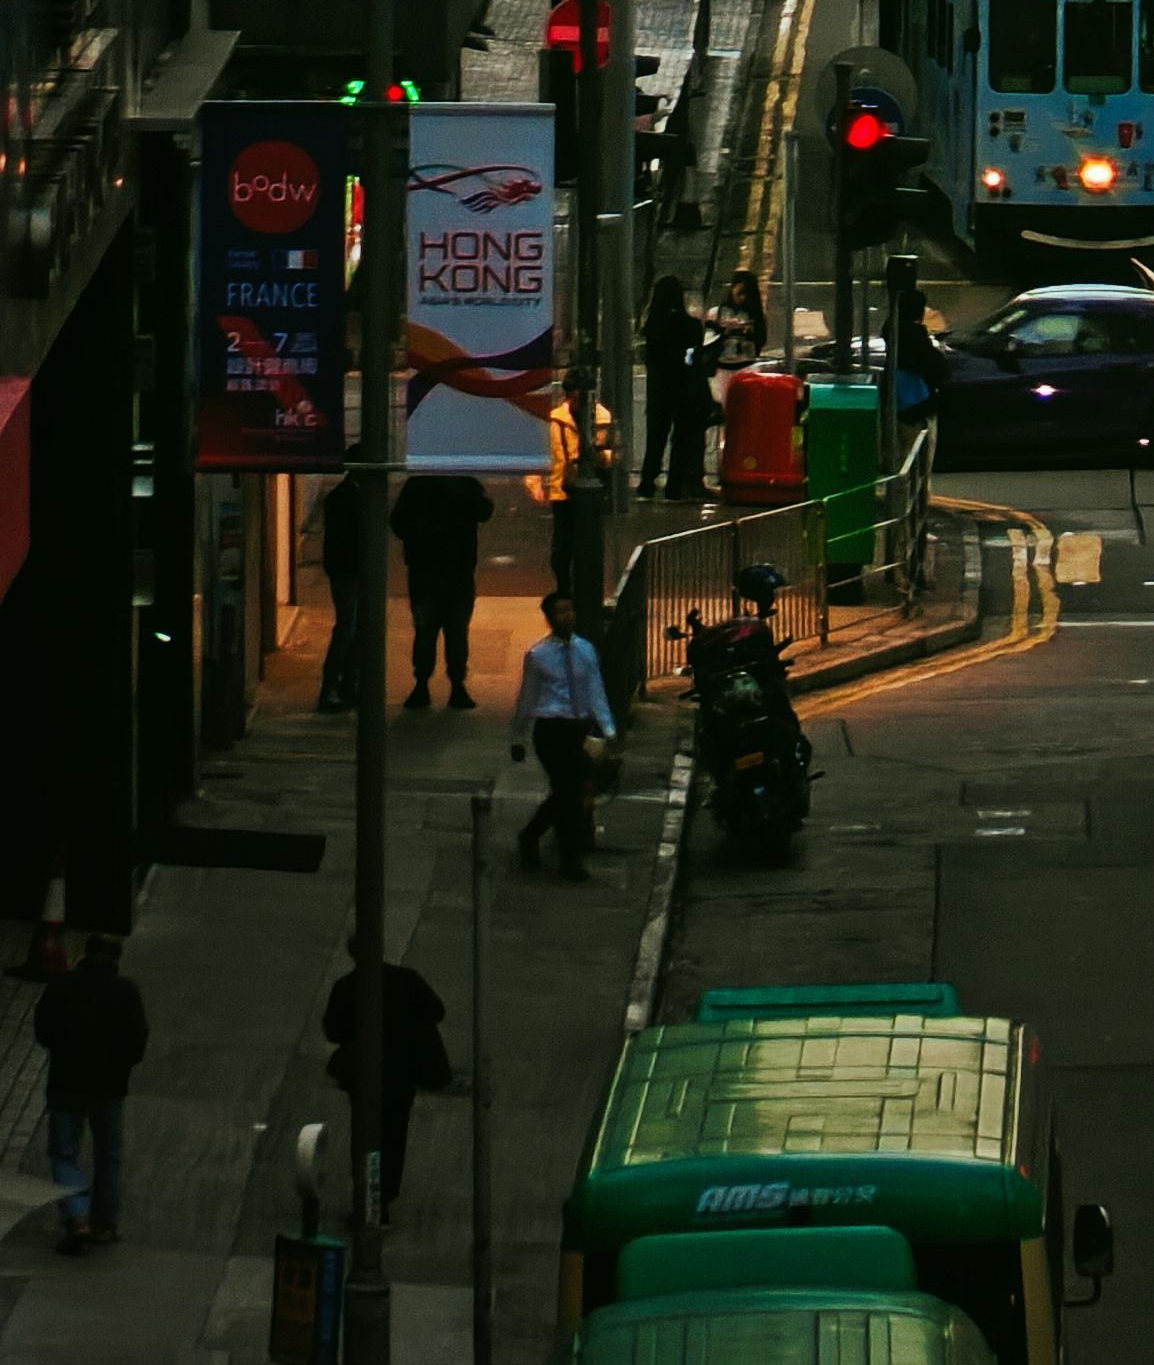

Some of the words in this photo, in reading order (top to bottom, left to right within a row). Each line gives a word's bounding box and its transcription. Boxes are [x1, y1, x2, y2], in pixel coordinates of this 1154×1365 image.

[232, 170, 317, 203] bodw
[419, 231, 544, 261] HONG
[419, 264, 543, 294] KONG
[226, 282, 319, 308] FRANCE
[227, 331, 241, 353] 2
[272, 331, 289, 354] 7
[696, 1180, 791, 1213] AMS
